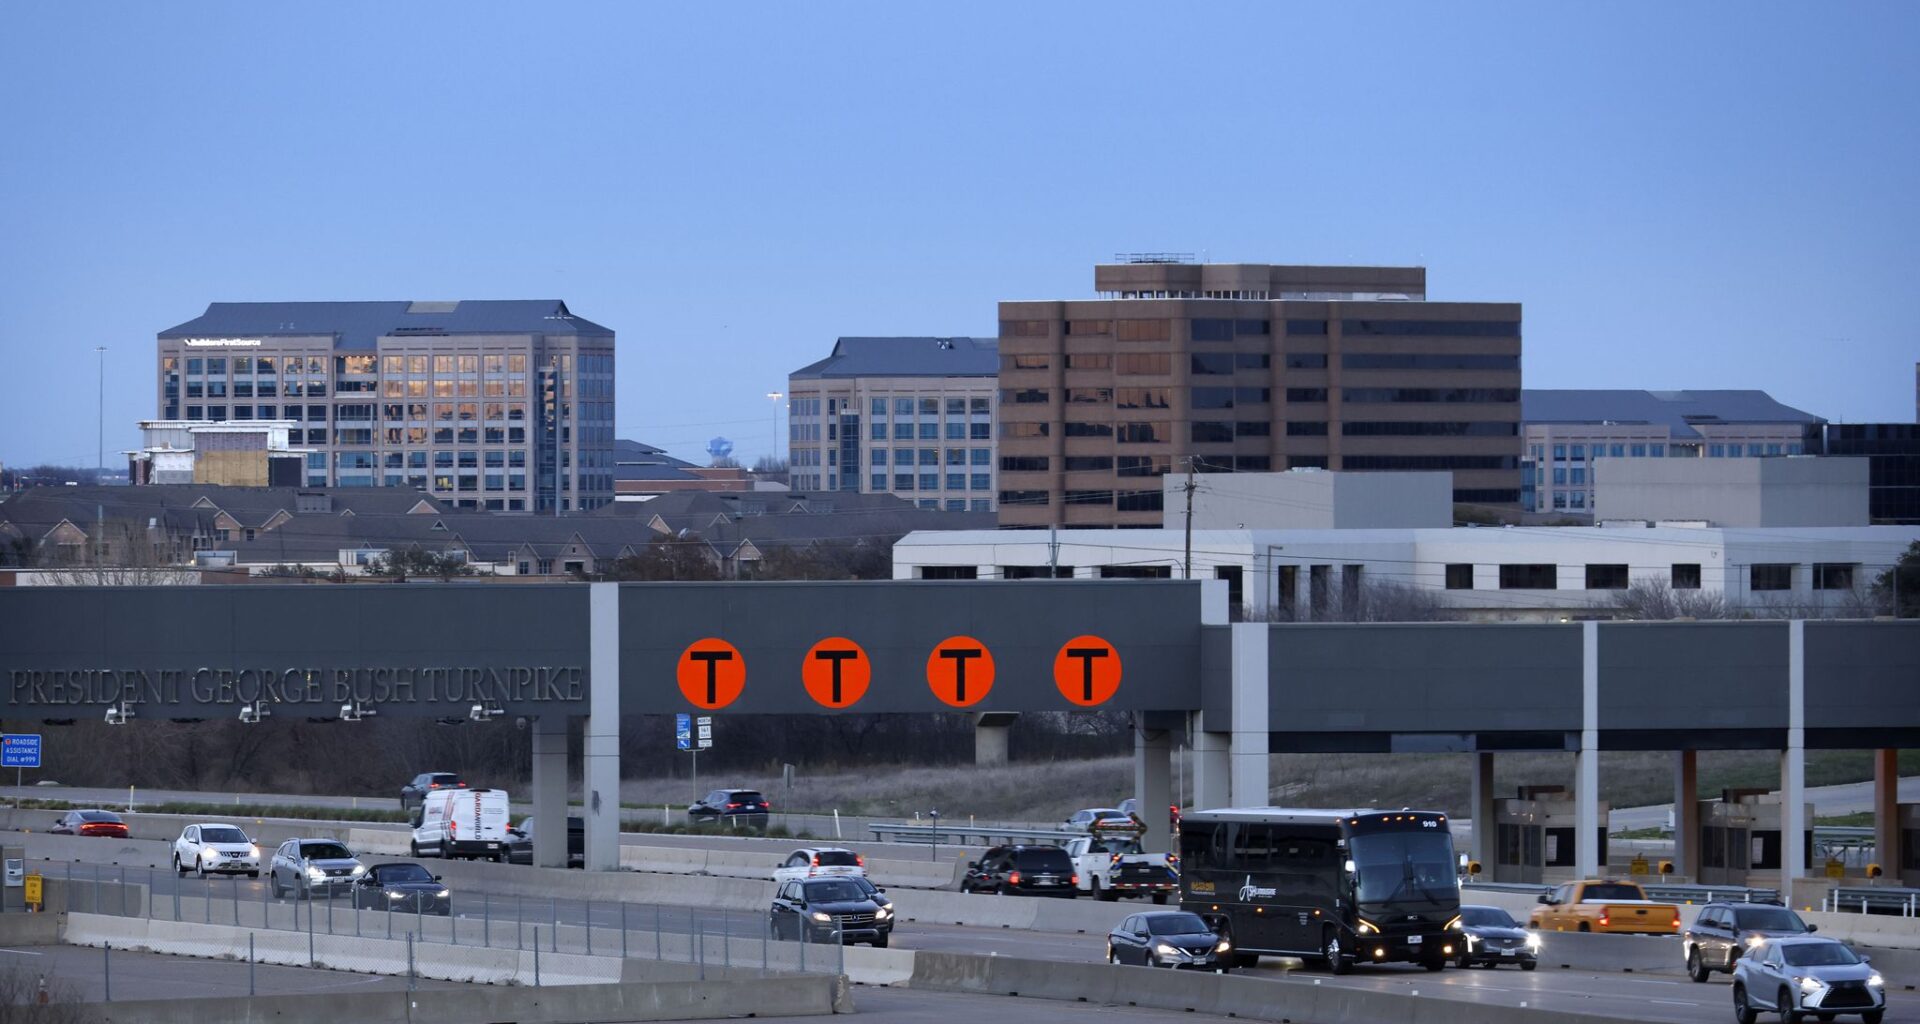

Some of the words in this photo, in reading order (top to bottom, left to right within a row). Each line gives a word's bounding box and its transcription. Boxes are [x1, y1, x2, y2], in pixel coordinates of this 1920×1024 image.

[8, 669, 182, 704] PRESIDENT
[191, 667, 323, 703] GEORGE
[333, 667, 416, 702] BUSH
[422, 666, 583, 702] TURNPIKE
[690, 651, 732, 704] T
[815, 650, 857, 703] T
[939, 649, 981, 702] T
[1067, 648, 1108, 701] T
[12, 738, 38, 746] ROADSIDE
